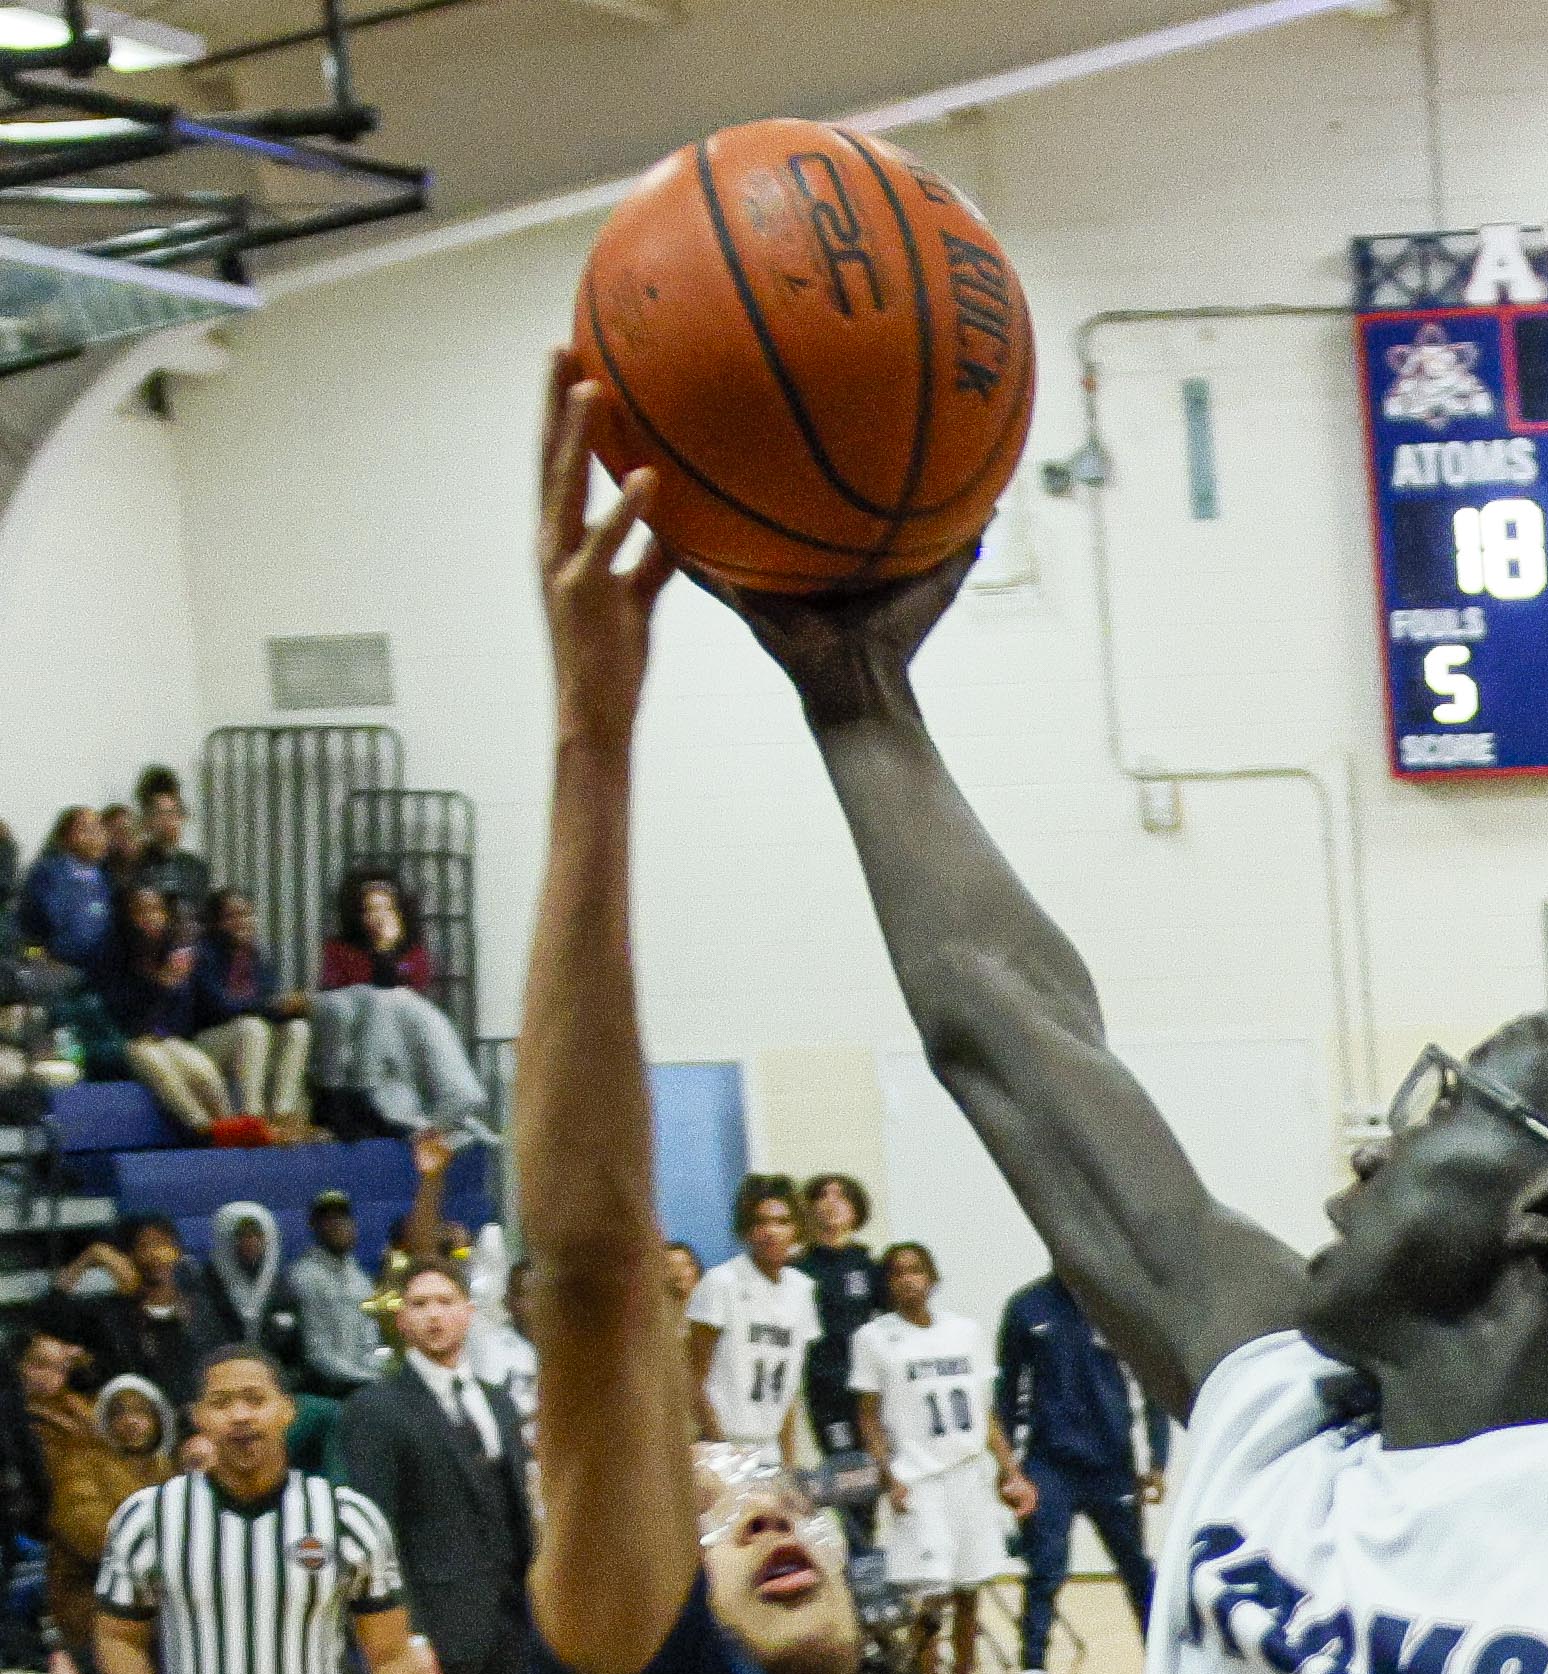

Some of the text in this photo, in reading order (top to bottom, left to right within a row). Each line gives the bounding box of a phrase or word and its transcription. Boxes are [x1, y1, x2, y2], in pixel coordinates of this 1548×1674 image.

[1391, 437, 1539, 490] ATOMS
[1453, 498, 1548, 600] 18
[1389, 606, 1487, 642] FOULS
[1424, 643, 1480, 724] 5
